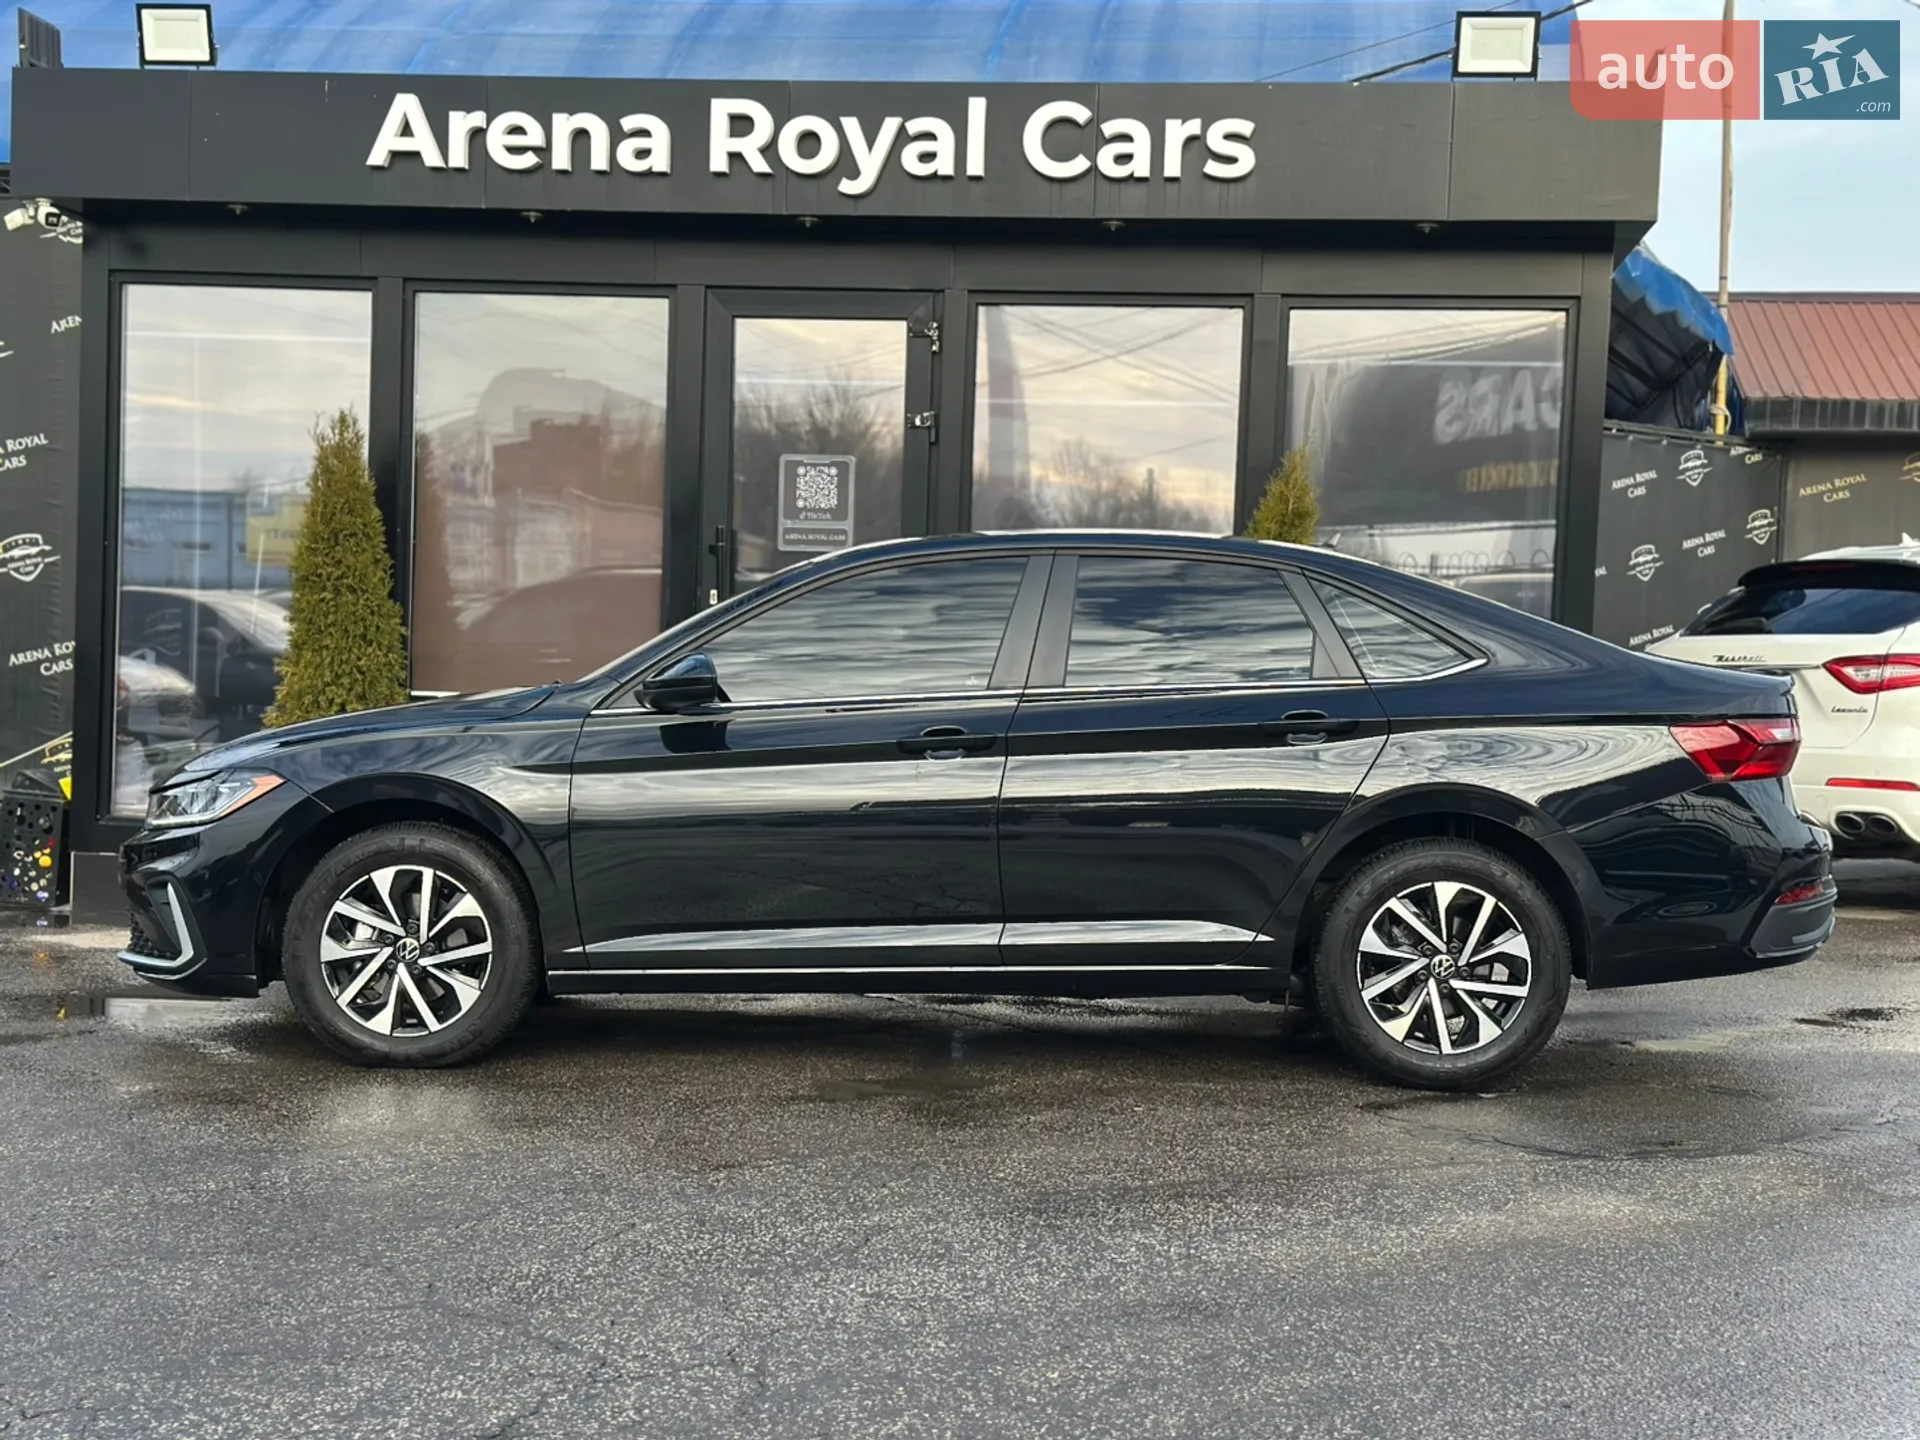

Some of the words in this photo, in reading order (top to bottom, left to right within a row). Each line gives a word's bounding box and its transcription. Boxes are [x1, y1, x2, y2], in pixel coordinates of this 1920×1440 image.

[366, 93, 671, 174] Arena
[709, 97, 987, 197] Royal
[1023, 100, 1256, 180] Cars
[5, 433, 49, 452] ROYAL
[1799, 481, 1833, 498] ARENA
[1834, 473, 1867, 489] ROYAL
[1823, 489, 1851, 503] CARS
[1682, 535, 1704, 550] ARENA
[1704, 528, 1727, 543] ROYAL
[1697, 544, 1716, 558] CARS
[1629, 631, 1652, 647] ARENA
[1651, 624, 1675, 639] ROYAL
[8, 647, 53, 668] ARENA
[53, 640, 76, 656] RO
[40, 658, 74, 676] CARS
